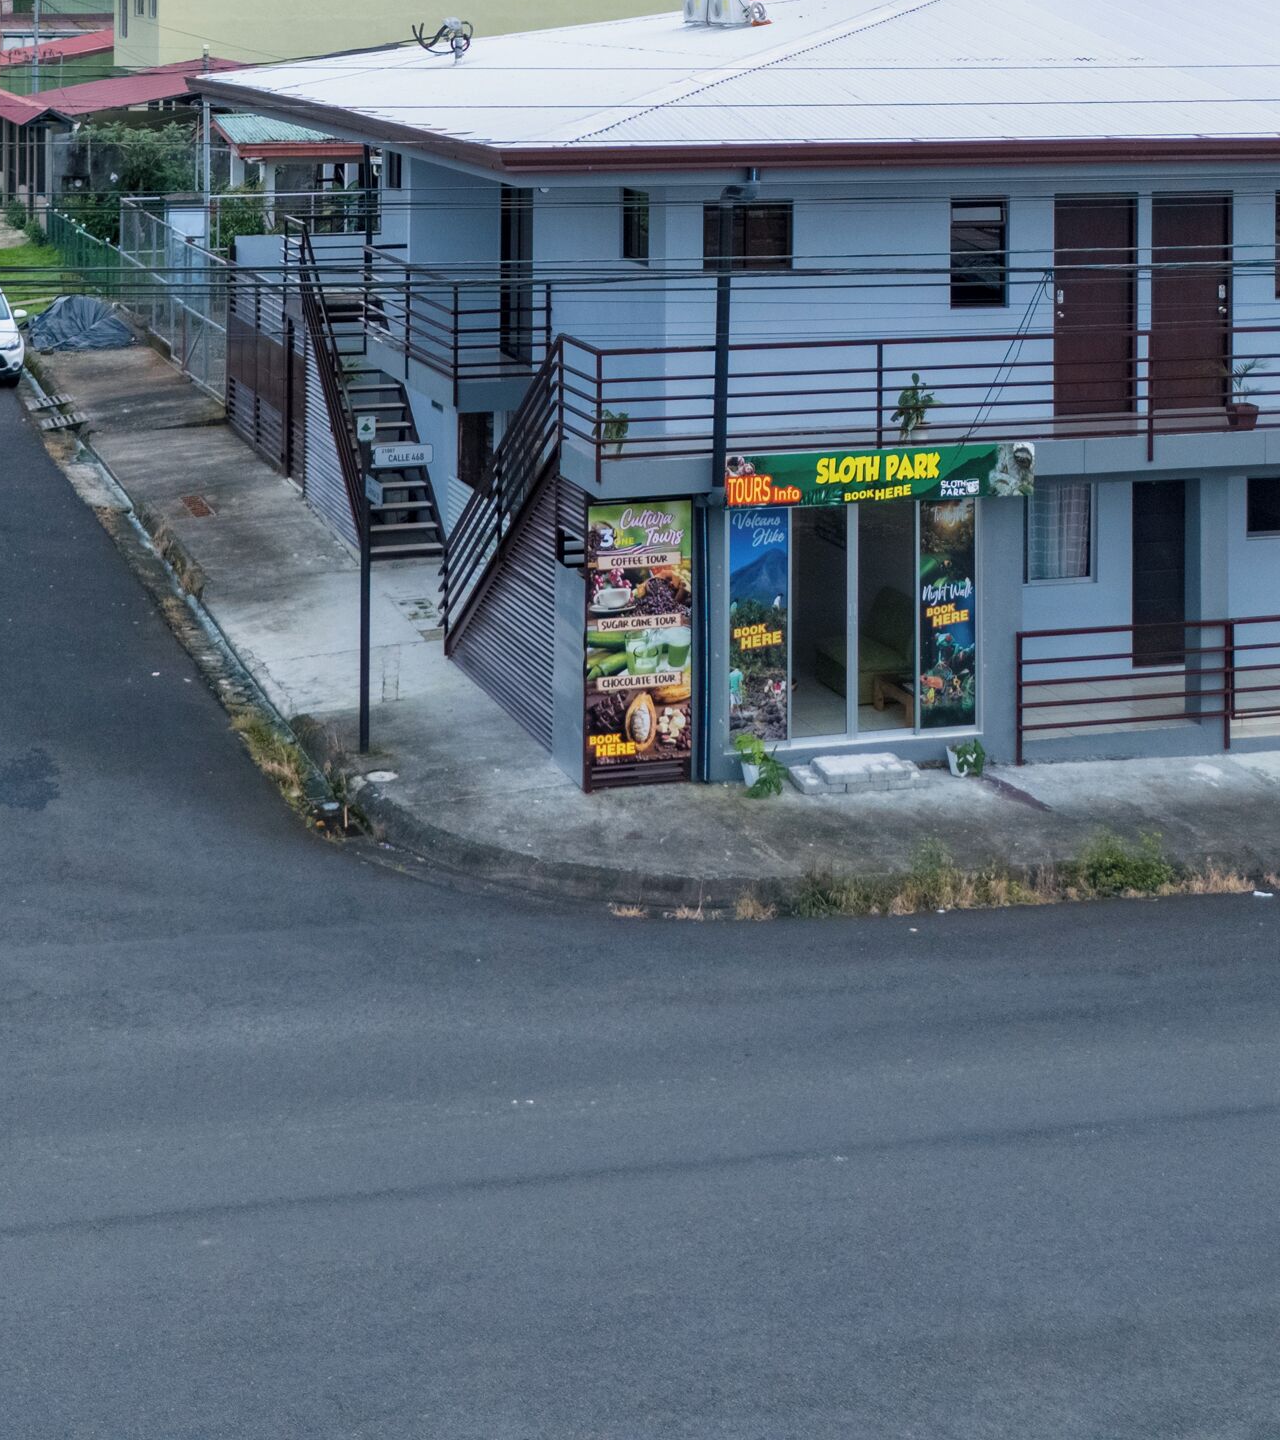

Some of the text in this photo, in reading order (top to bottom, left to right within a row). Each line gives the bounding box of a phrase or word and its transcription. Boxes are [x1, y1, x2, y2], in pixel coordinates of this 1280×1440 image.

[388, 454, 410, 462] CALLE
[815, 451, 941, 484] SLOTH PARK
[728, 476, 801, 503] TOURS Info
[844, 484, 912, 502] BOOK HERE
[940, 479, 966, 489] SLOTH
[940, 488, 966, 497] PARK
[620, 508, 674, 530] Cultura
[732, 511, 781, 530] Volcano
[599, 527, 614, 548] 3
[645, 527, 684, 546] Tours
[752, 528, 785, 547] Hike
[610, 554, 668, 567] COFFEE TOUR
[922, 577, 973, 607] Night Walk
[926, 603, 956, 618] BOOK
[932, 609, 969, 628] HERE
[601, 616, 677, 630] SUGAR CANE TOUR
[733, 623, 767, 639] BOOK
[741, 630, 782, 650] HERE
[602, 674, 676, 688] CHOCOLATE TOUR
[589, 734, 621, 746] BOOK
[596, 742, 636, 757] HERE
